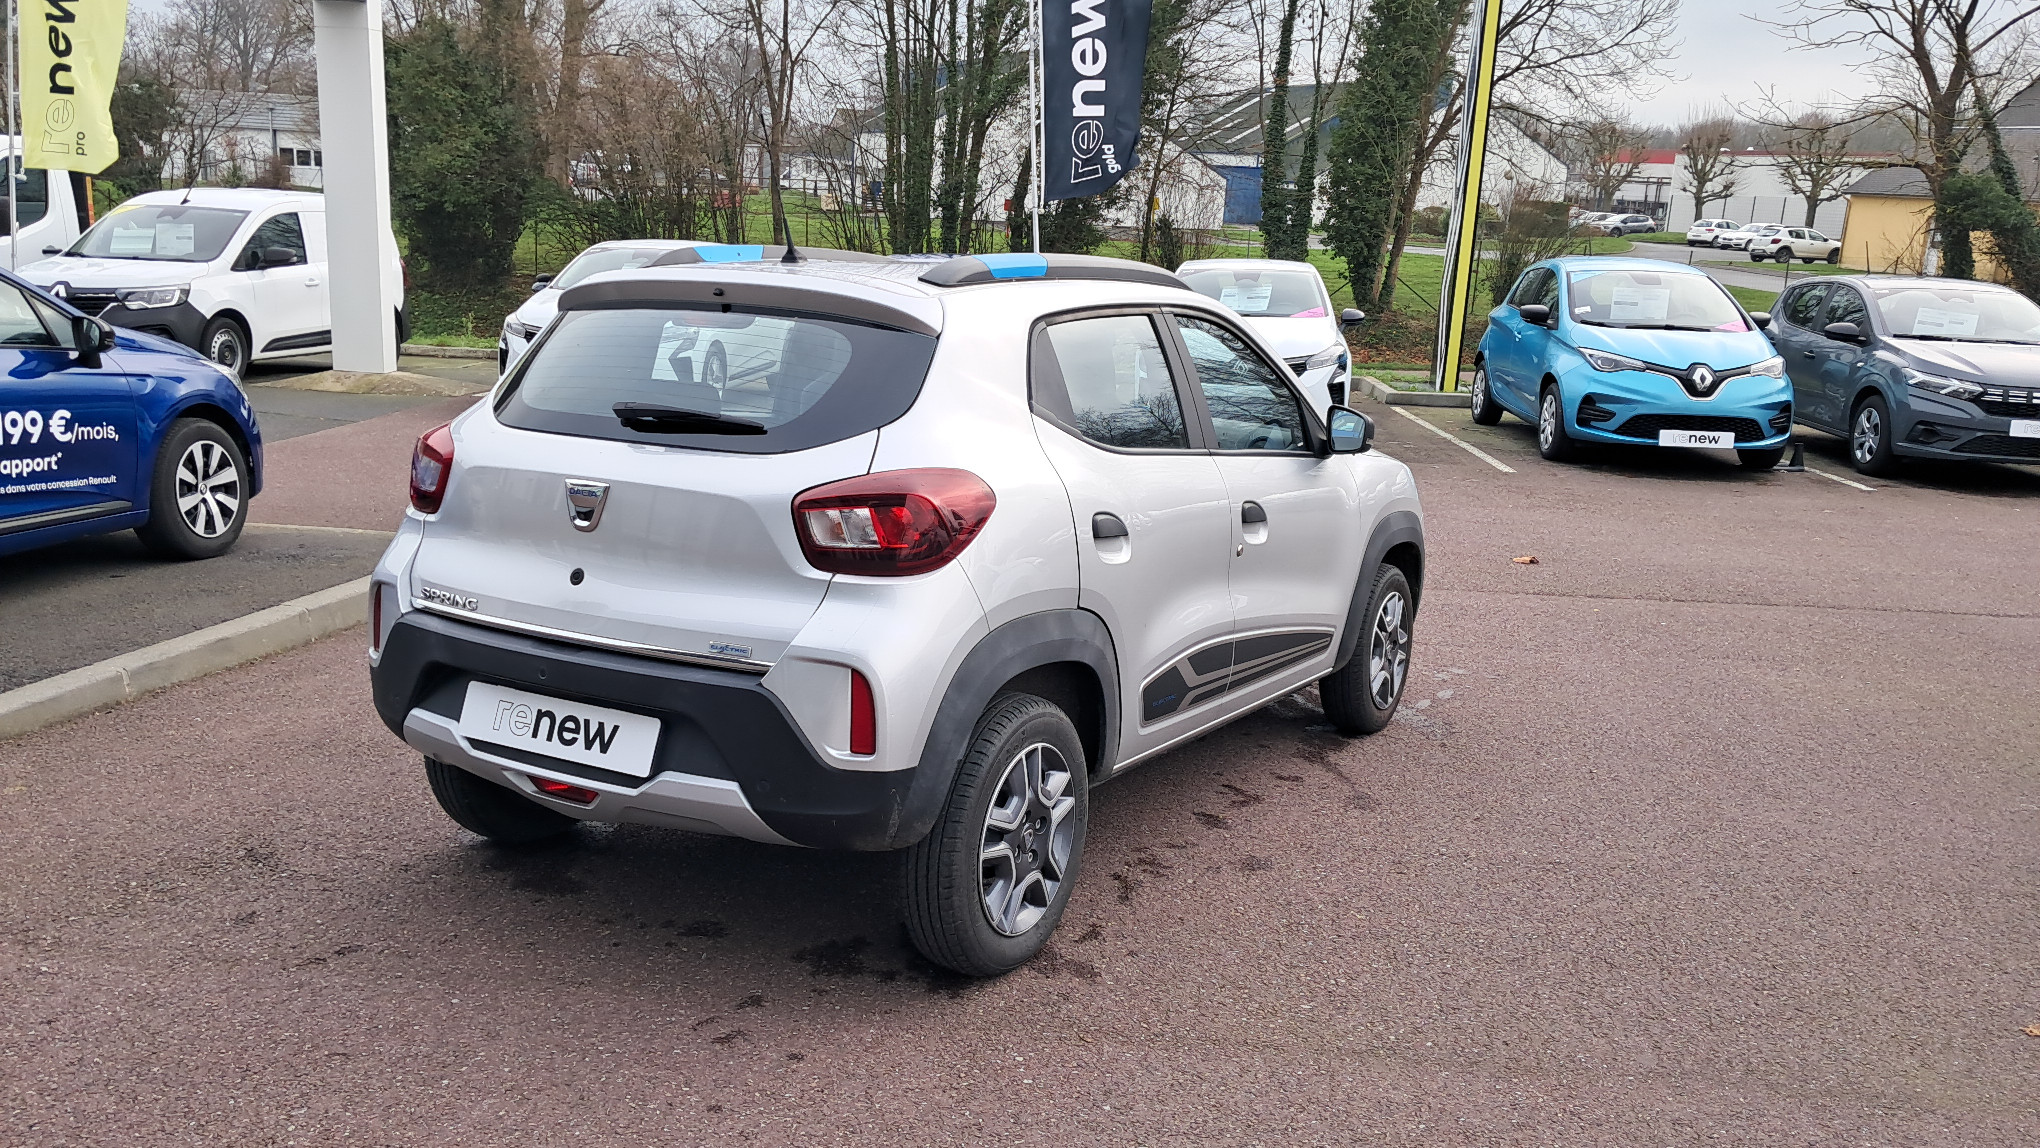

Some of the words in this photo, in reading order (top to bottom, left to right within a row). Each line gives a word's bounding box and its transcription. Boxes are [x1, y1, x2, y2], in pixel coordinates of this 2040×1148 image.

[76, 131, 87, 156] pro
[1102, 144, 1121, 174] gold
[1672, 433, 1720, 444] renew
[6, 484, 26, 494] dans
[26, 482, 46, 492] votre
[47, 478, 89, 490] concession
[88, 474, 117, 485] Renault
[420, 586, 479, 611] SPRING
[492, 699, 620, 755] renew
